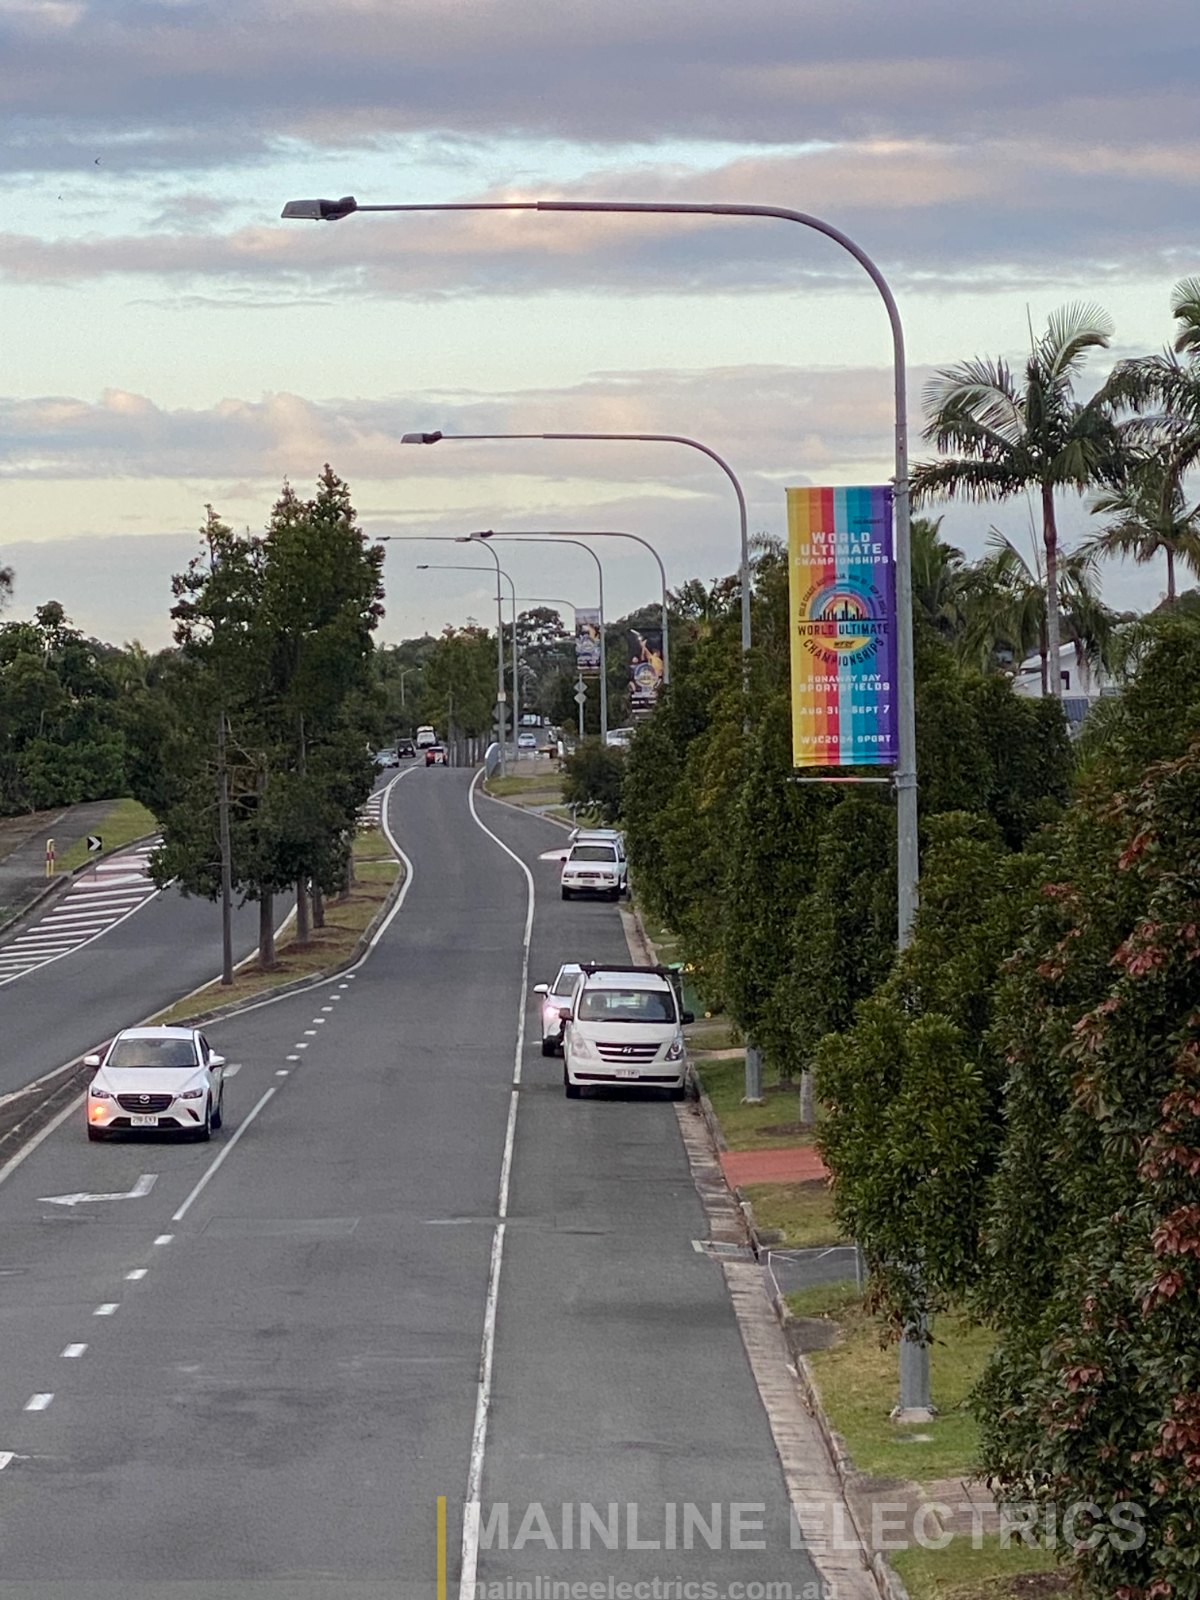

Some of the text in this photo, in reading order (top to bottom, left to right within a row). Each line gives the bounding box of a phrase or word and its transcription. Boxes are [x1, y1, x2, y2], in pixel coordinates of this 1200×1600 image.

[811, 532, 871, 543] WORLD
[800, 543, 882, 556] ULTIMATE
[794, 555, 889, 566] CHAMPIONSHIPS
[797, 622, 889, 636] WORLD ULTIMATE
[803, 637, 884, 667] CHAMPIONSHIPS
[807, 674, 882, 683] RUNAWAY BAY
[800, 706, 823, 715] AUG
[826, 706, 839, 715] 31
[851, 706, 879, 715] SEPT
[883, 705, 890, 714] 7
